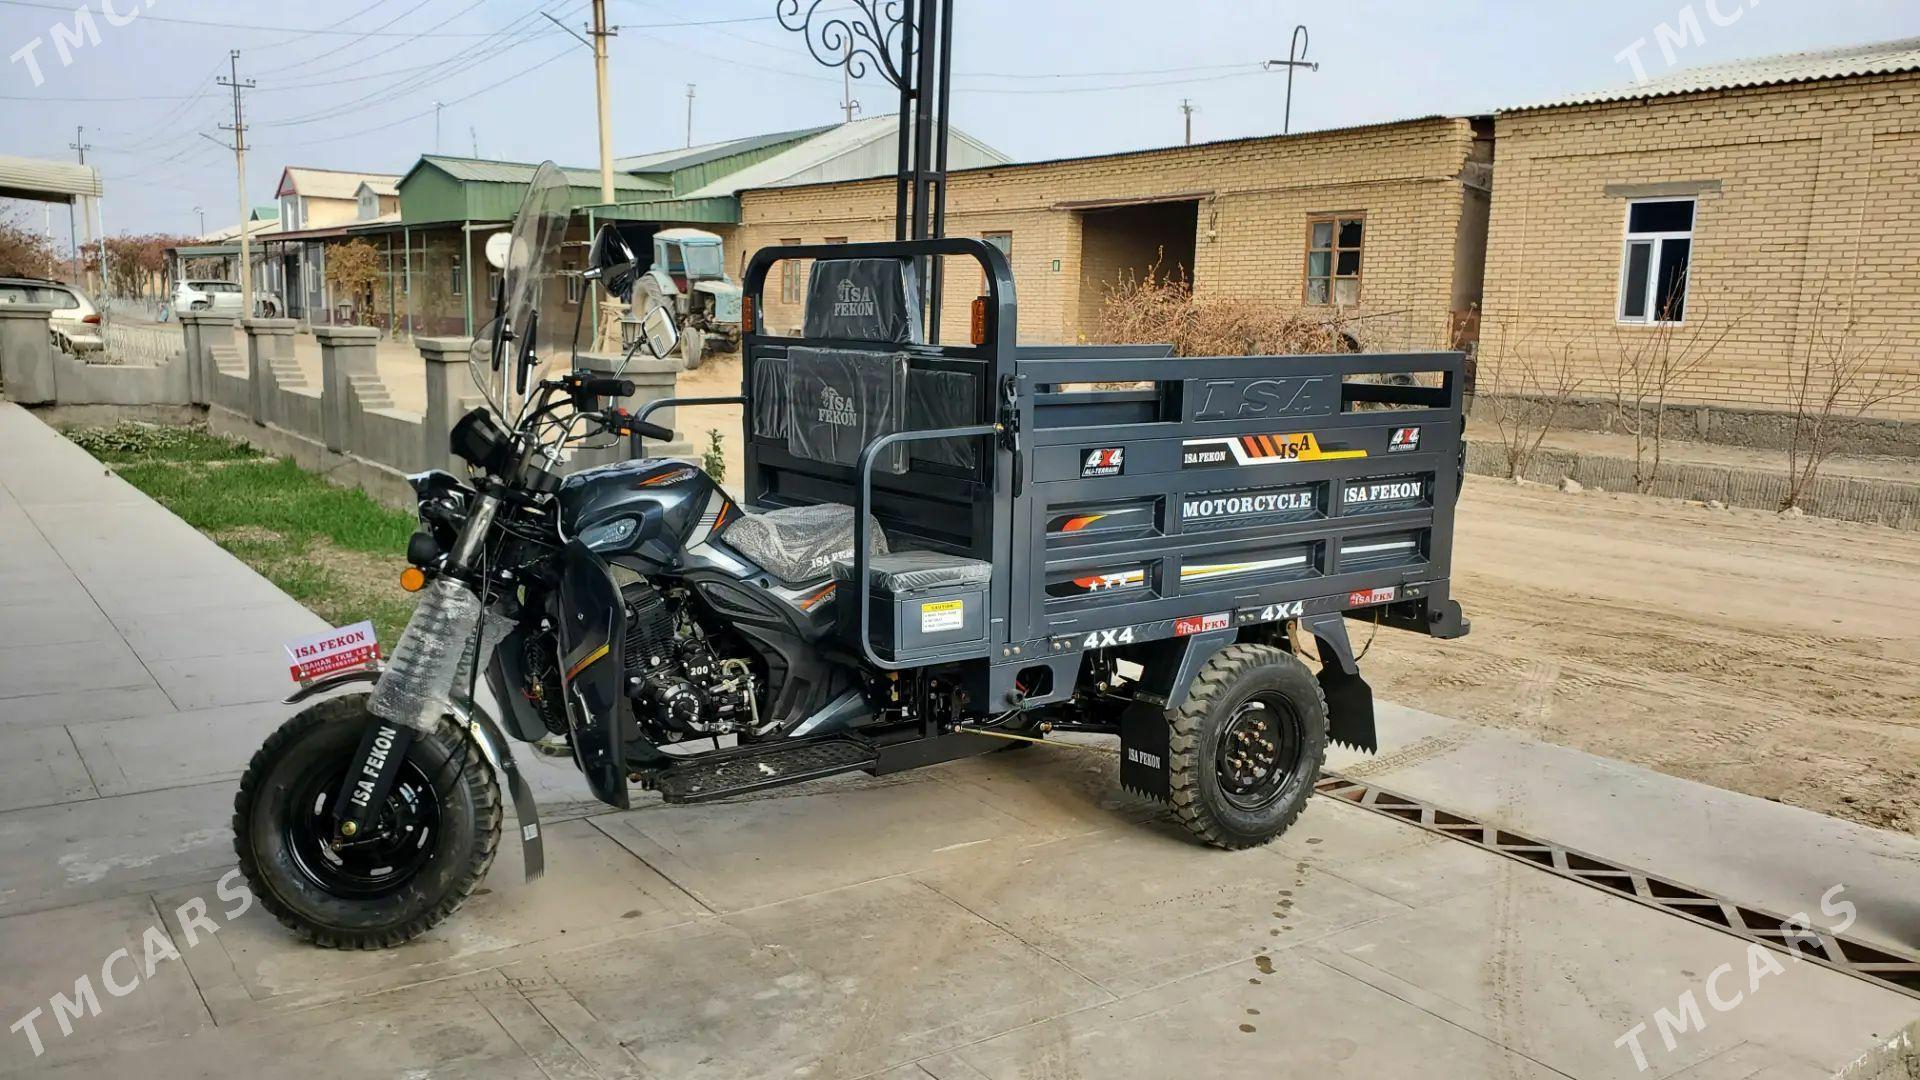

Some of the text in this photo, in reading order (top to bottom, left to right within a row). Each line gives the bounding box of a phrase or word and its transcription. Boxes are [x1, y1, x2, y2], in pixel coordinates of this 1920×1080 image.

[843, 286, 871, 302] ISA
[834, 302, 874, 316] FEKON
[828, 396, 855, 412] ISA
[1195, 379, 1330, 416] ISA
[818, 408, 857, 426] FEKON
[1184, 451, 1226, 463] ISA FEKON
[1280, 435, 1311, 460] ISA
[1344, 482, 1422, 502] ISA FEKON
[1183, 492, 1312, 518] MOTORCYCLE
[1261, 600, 1304, 621] 4X4
[1182, 620, 1228, 634] ISA FKN
[295, 631, 365, 659] ISA FEKON
[1083, 626, 1134, 649] 4X4
[690, 665, 709, 676] 200
[351, 725, 397, 807] ISA FEKON
[1128, 747, 1161, 769] ISA FEKON
